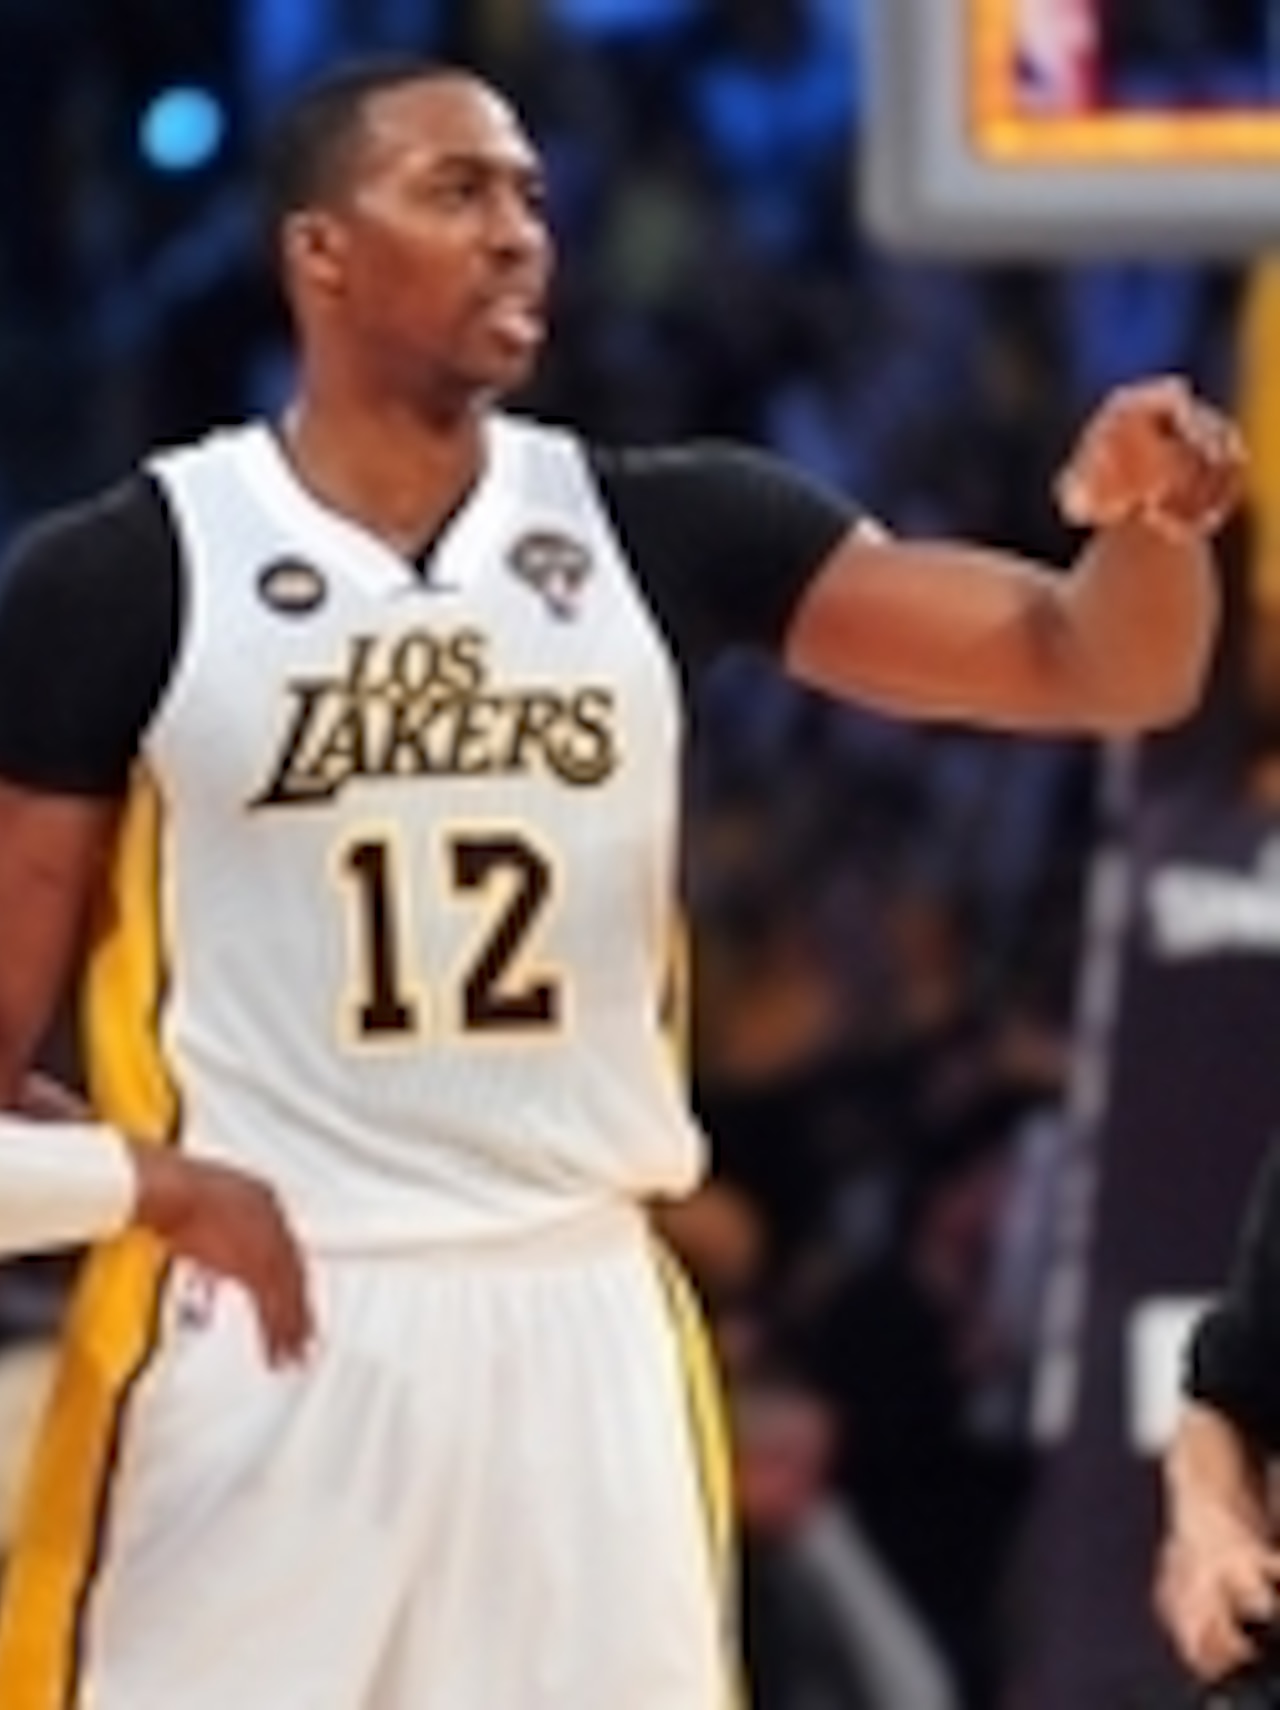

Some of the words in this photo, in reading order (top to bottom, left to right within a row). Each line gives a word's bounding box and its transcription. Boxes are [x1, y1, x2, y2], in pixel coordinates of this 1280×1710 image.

[345, 627, 489, 698] LOS
[246, 677, 619, 812] LAKERS
[341, 831, 564, 1039] 12
